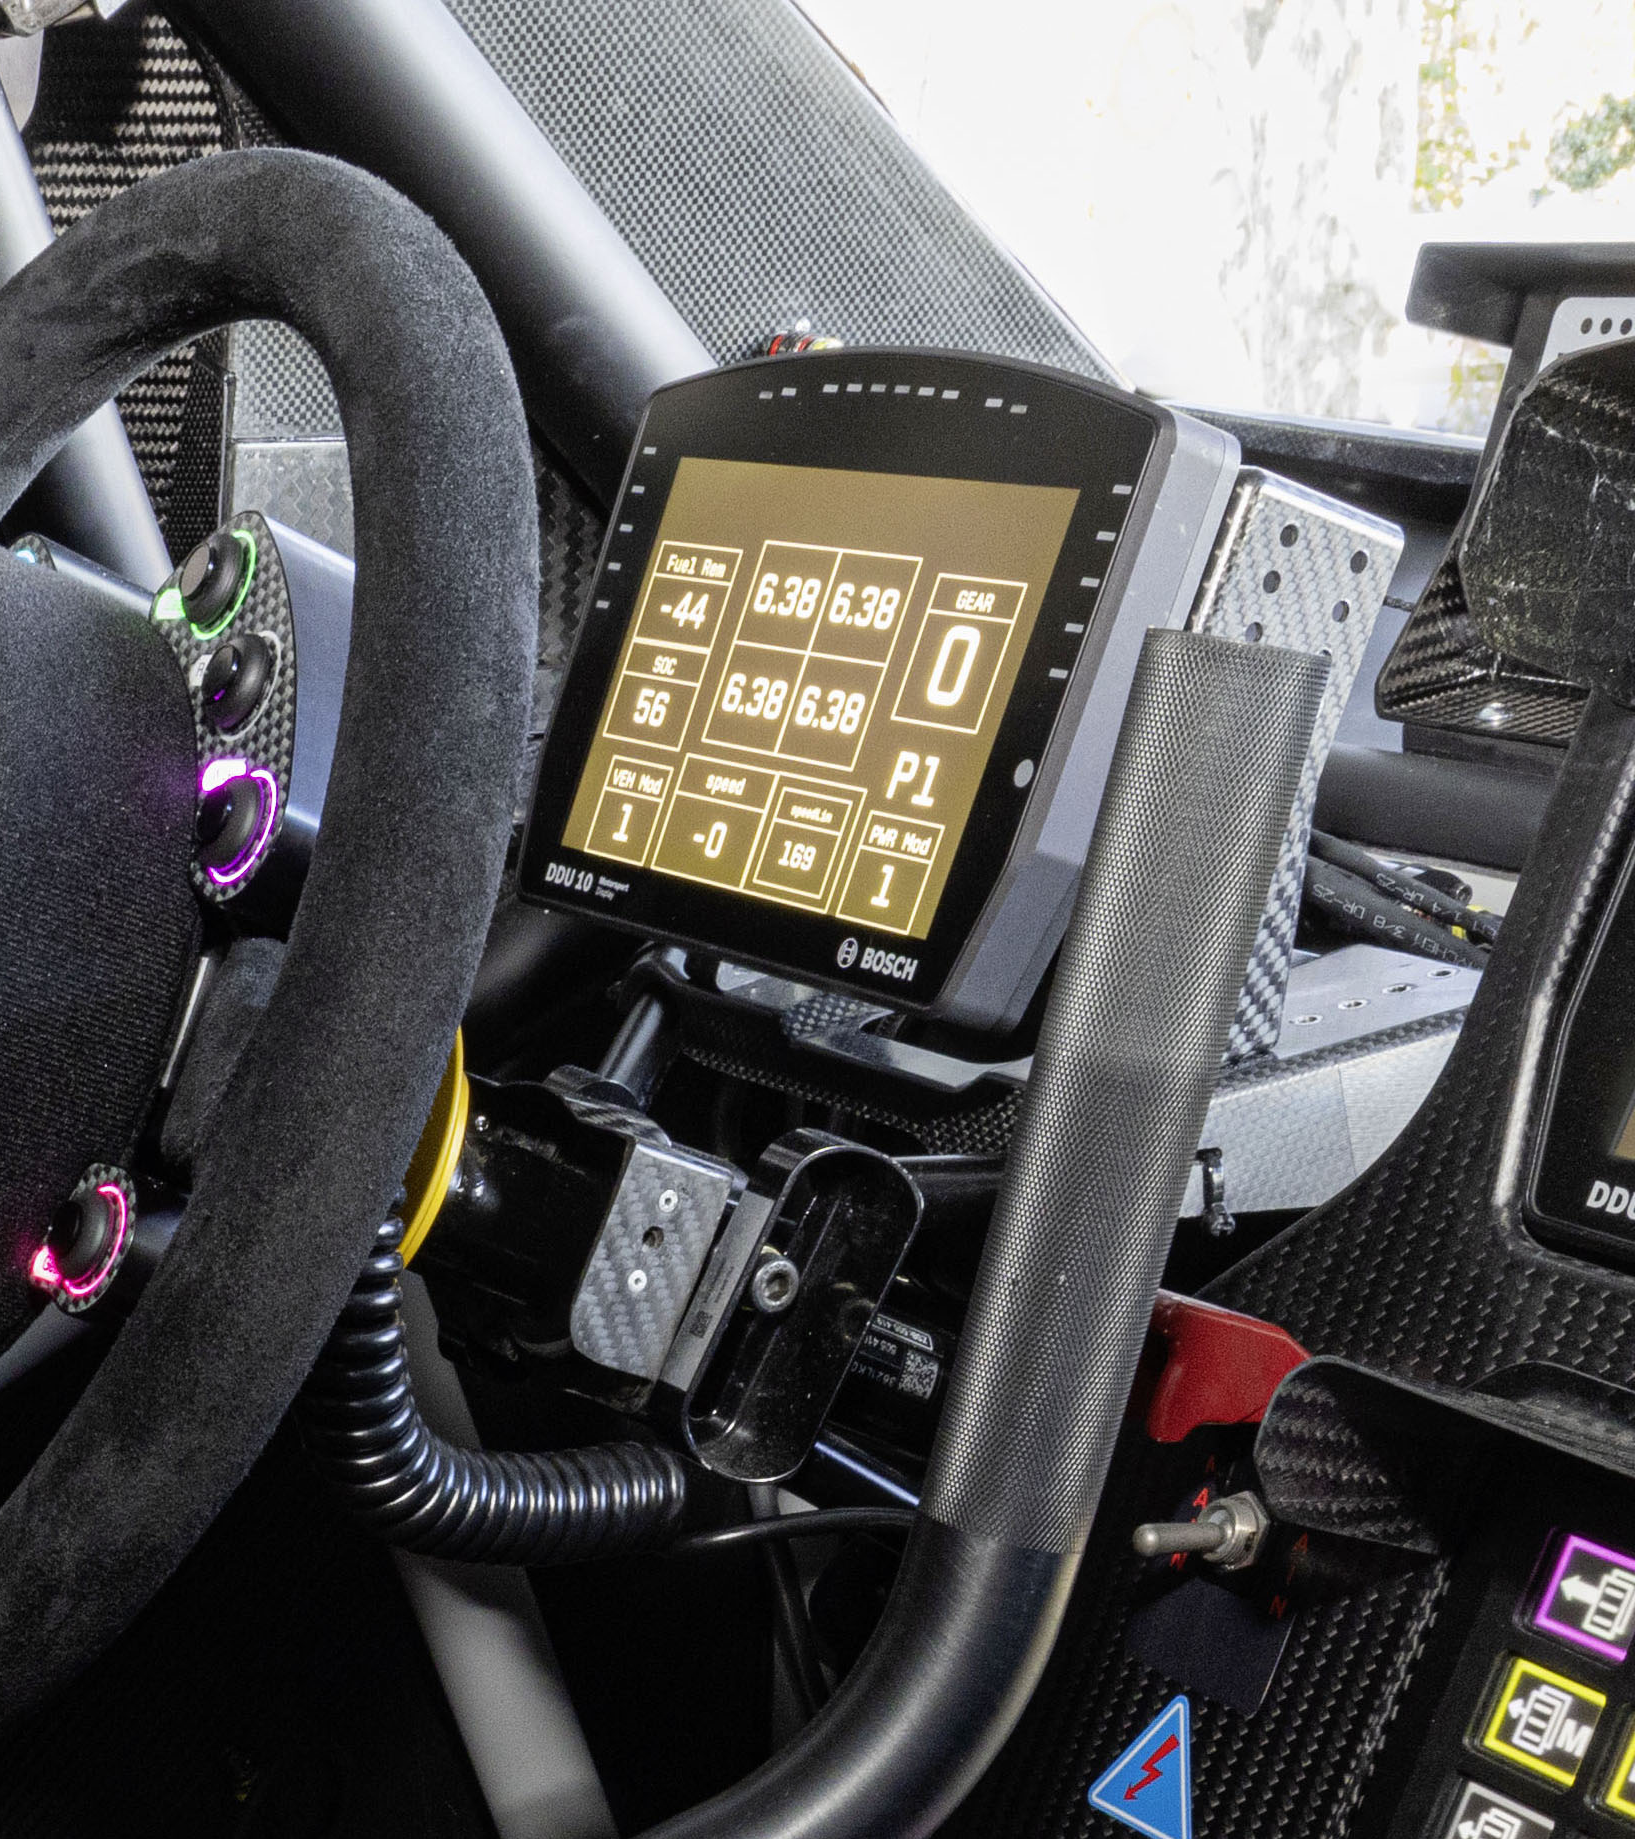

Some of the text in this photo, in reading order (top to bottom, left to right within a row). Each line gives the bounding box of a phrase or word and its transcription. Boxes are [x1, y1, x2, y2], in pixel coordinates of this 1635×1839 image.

[667, 553, 726, 580] Fuel Rem
[660, 590, 706, 630] -44
[753, 571, 900, 631] 6.38 6.38
[956, 589, 994, 615] GEAR
[652, 654, 676, 675] SOC
[928, 625, 980, 707] 0
[633, 690, 670, 727] 56
[722, 671, 865, 735] 6.38 6.38
[612, 765, 663, 795] VEH Mod
[704, 771, 745, 797] speed
[887, 750, 939, 806] P1
[611, 802, 631, 843] 1
[692, 820, 727, 858] -0
[868, 822, 931, 856] PWR Mod
[777, 840, 815, 872] 169
[546, 863, 593, 893] DDU 10
[868, 864, 891, 908] 1
[1313, 884, 1365, 919] DR-25
[1374, 915, 1406, 939] 3/8
[861, 945, 917, 981] BOSCH
